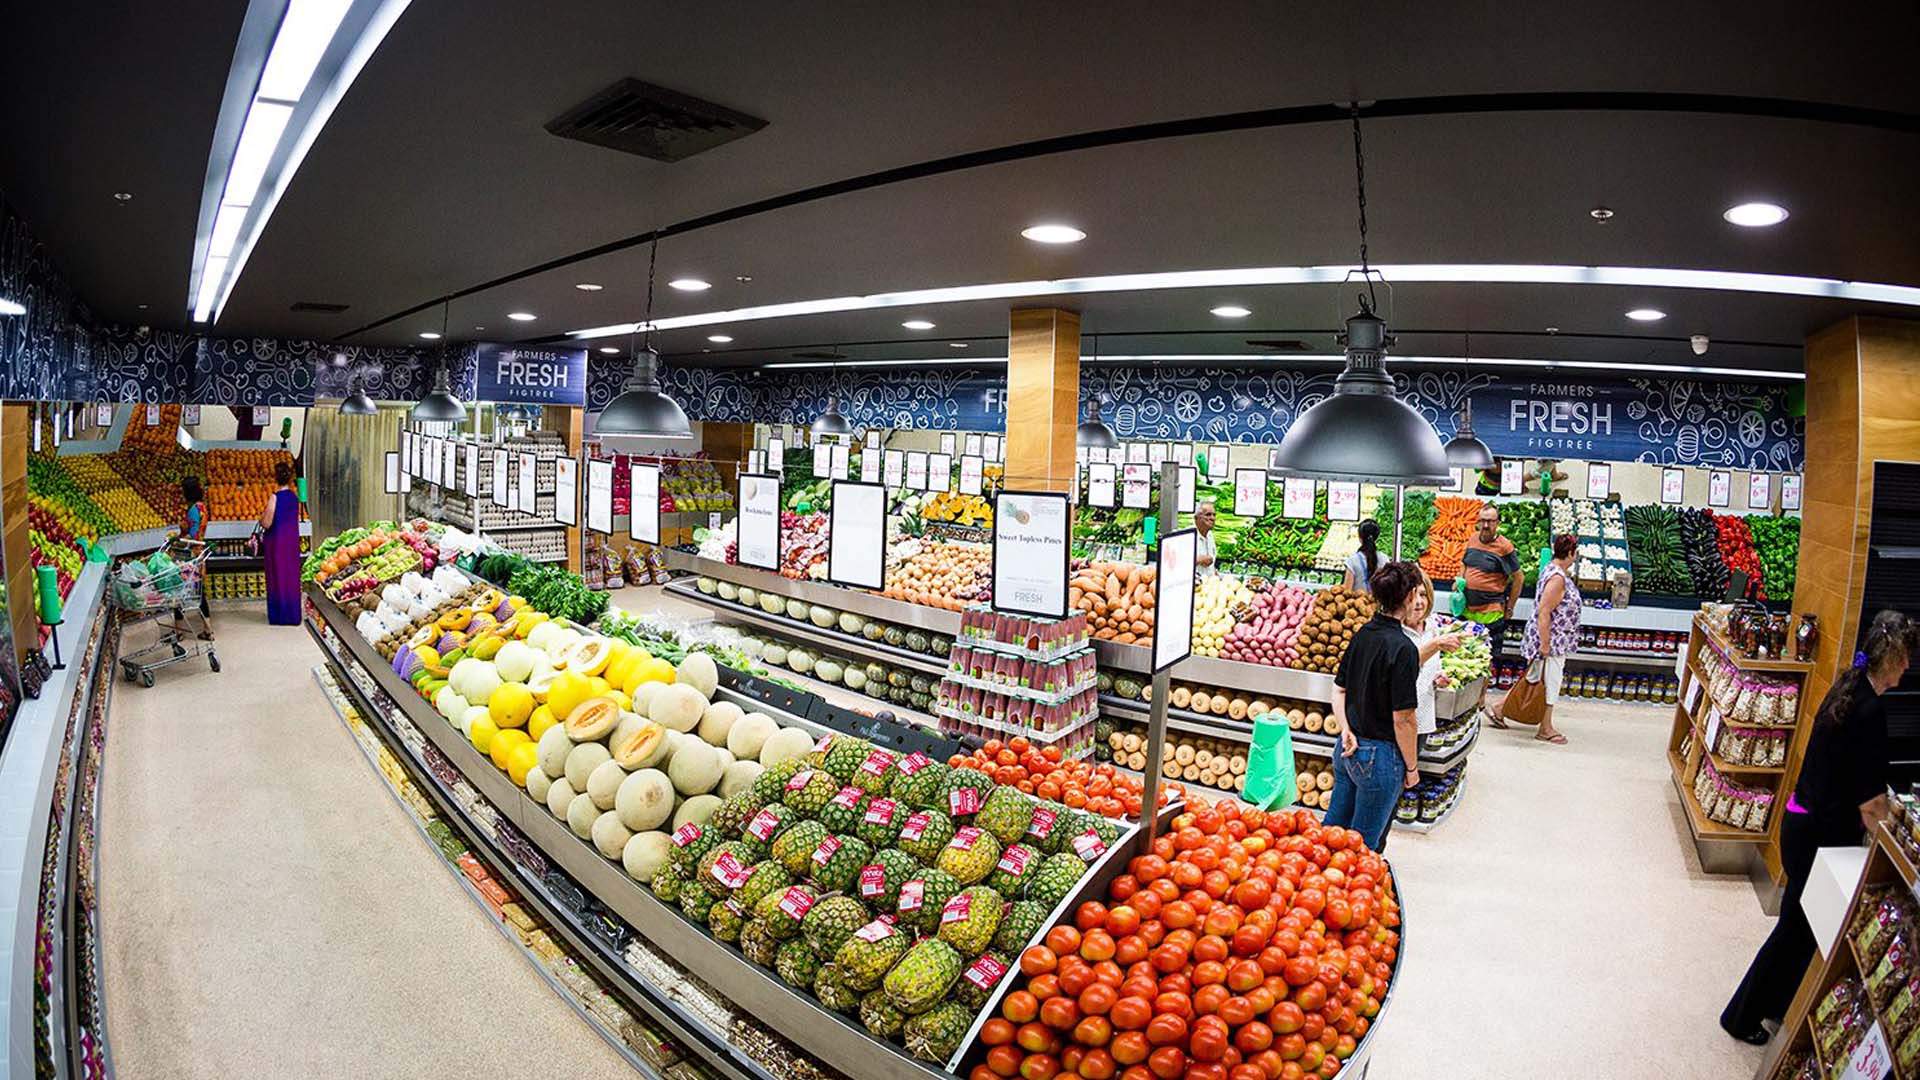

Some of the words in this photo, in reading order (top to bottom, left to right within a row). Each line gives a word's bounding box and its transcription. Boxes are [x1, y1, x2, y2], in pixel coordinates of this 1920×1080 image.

[511, 349, 556, 361] FARMERS
[496, 360, 568, 388] FRESH
[509, 389, 554, 398] FIGTREE
[1530, 383, 1594, 397] FARMERS
[1510, 399, 1612, 435] FRESH
[1528, 437, 1592, 450] FIGTREE
[1014, 591, 1043, 603] FRESH
